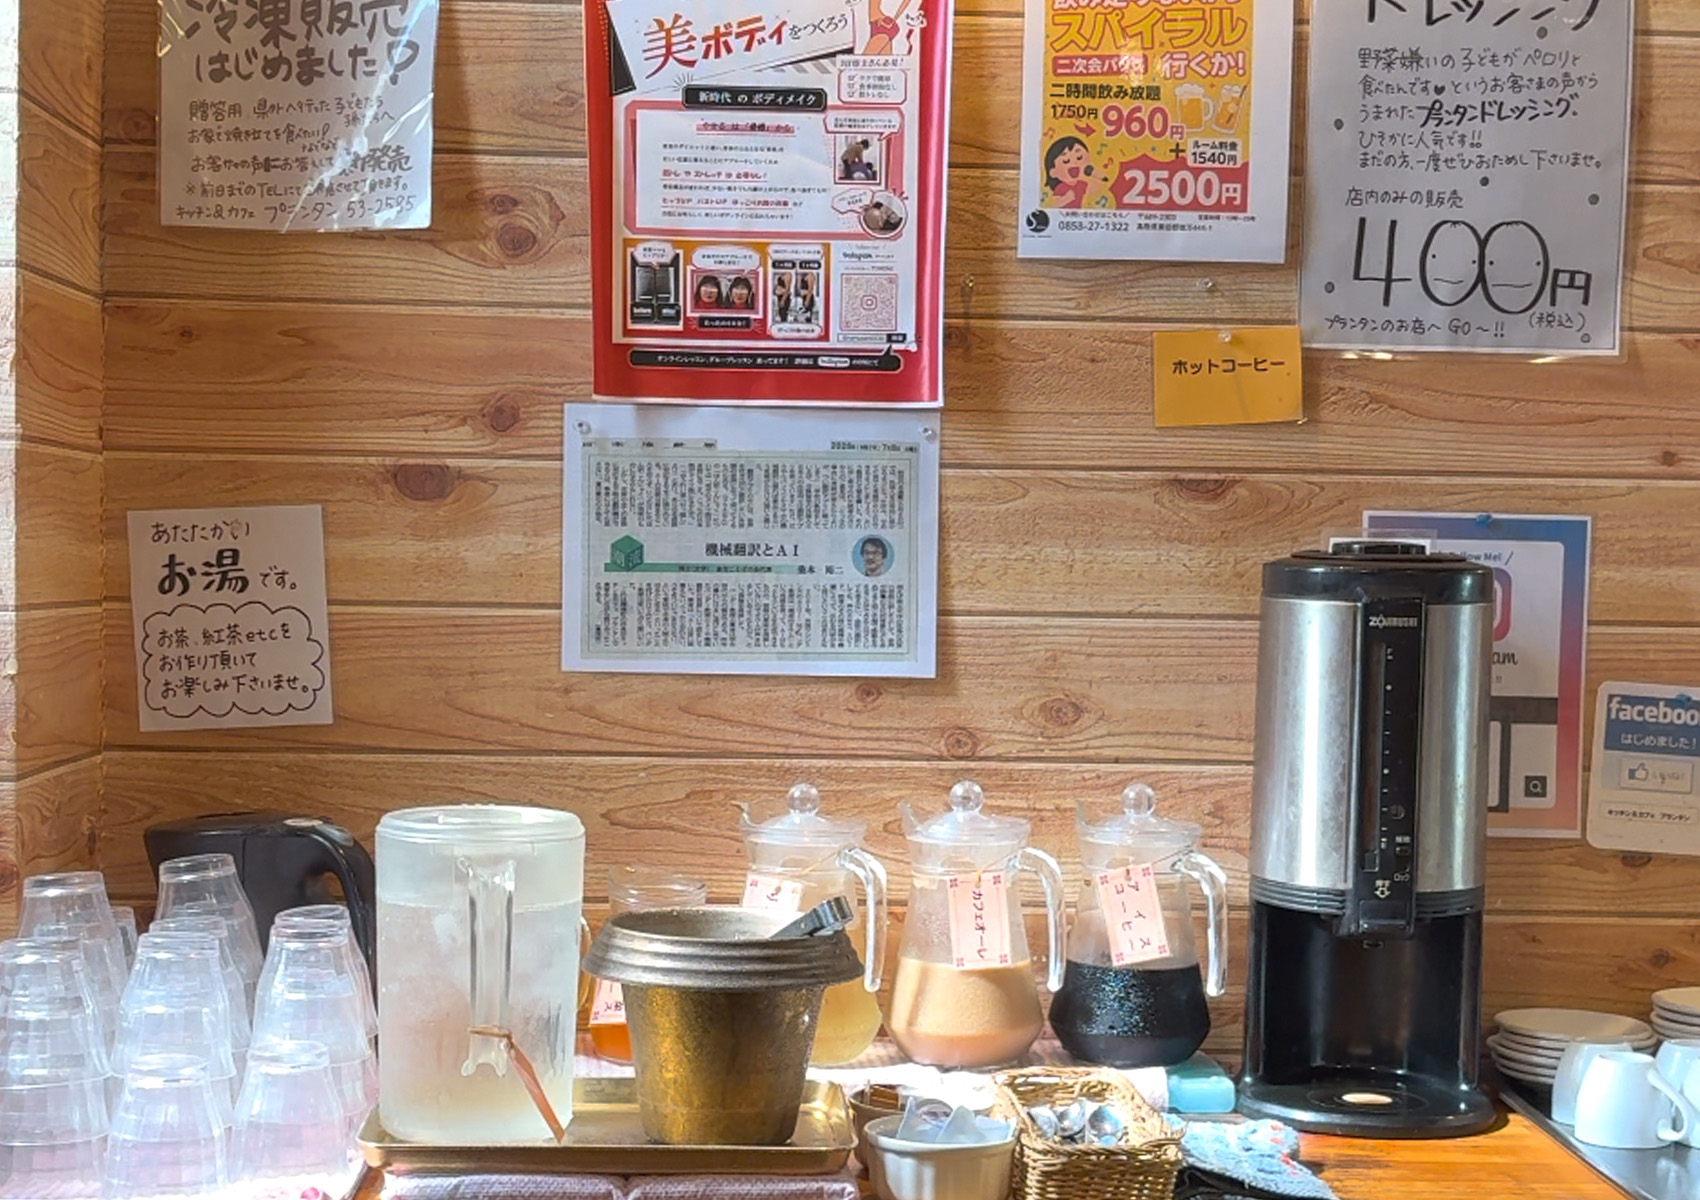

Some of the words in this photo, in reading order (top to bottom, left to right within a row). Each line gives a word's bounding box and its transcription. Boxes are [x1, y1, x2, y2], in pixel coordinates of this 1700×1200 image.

[1050, 8, 1248, 52] スパイラル
[642, 12, 848, 79] 美ボディをつくろう
[1163, 53, 1246, 78] 行くか!
[1358, 47, 1581, 72] 野菜嫌いの子どもがペロリと
[699, 91, 731, 103] 新時代
[737, 94, 748, 103] の
[752, 93, 816, 106] ボディメイク
[1050, 82, 1161, 101] 二時間飲み放題
[1051, 105, 1098, 119] 1750円
[1102, 105, 1185, 140] 960円
[1358, 93, 1579, 128] うまれたプランタンドレッシング。
[1192, 141, 1238, 151] ルーム料金
[1191, 152, 1238, 166] 1540円
[1358, 150, 1602, 171] まだの方、一度ぜひおためし下さいませ。
[1122, 169, 1242, 206] 2500円
[1345, 187, 1464, 208] 店内のみの販売
[1352, 216, 1593, 315] 400円
[1324, 315, 1442, 335] プランタンのお店へ
[1172, 357, 1286, 375] ホットコーヒー
[157, 623, 292, 649] お茶、紅茶etcを
[158, 650, 257, 672] お作り頂いて
[160, 674, 309, 699] お楽しみ下さいませ。
[1609, 696, 1700, 727] faceboo
[1620, 732, 1697, 750] はじめました!
